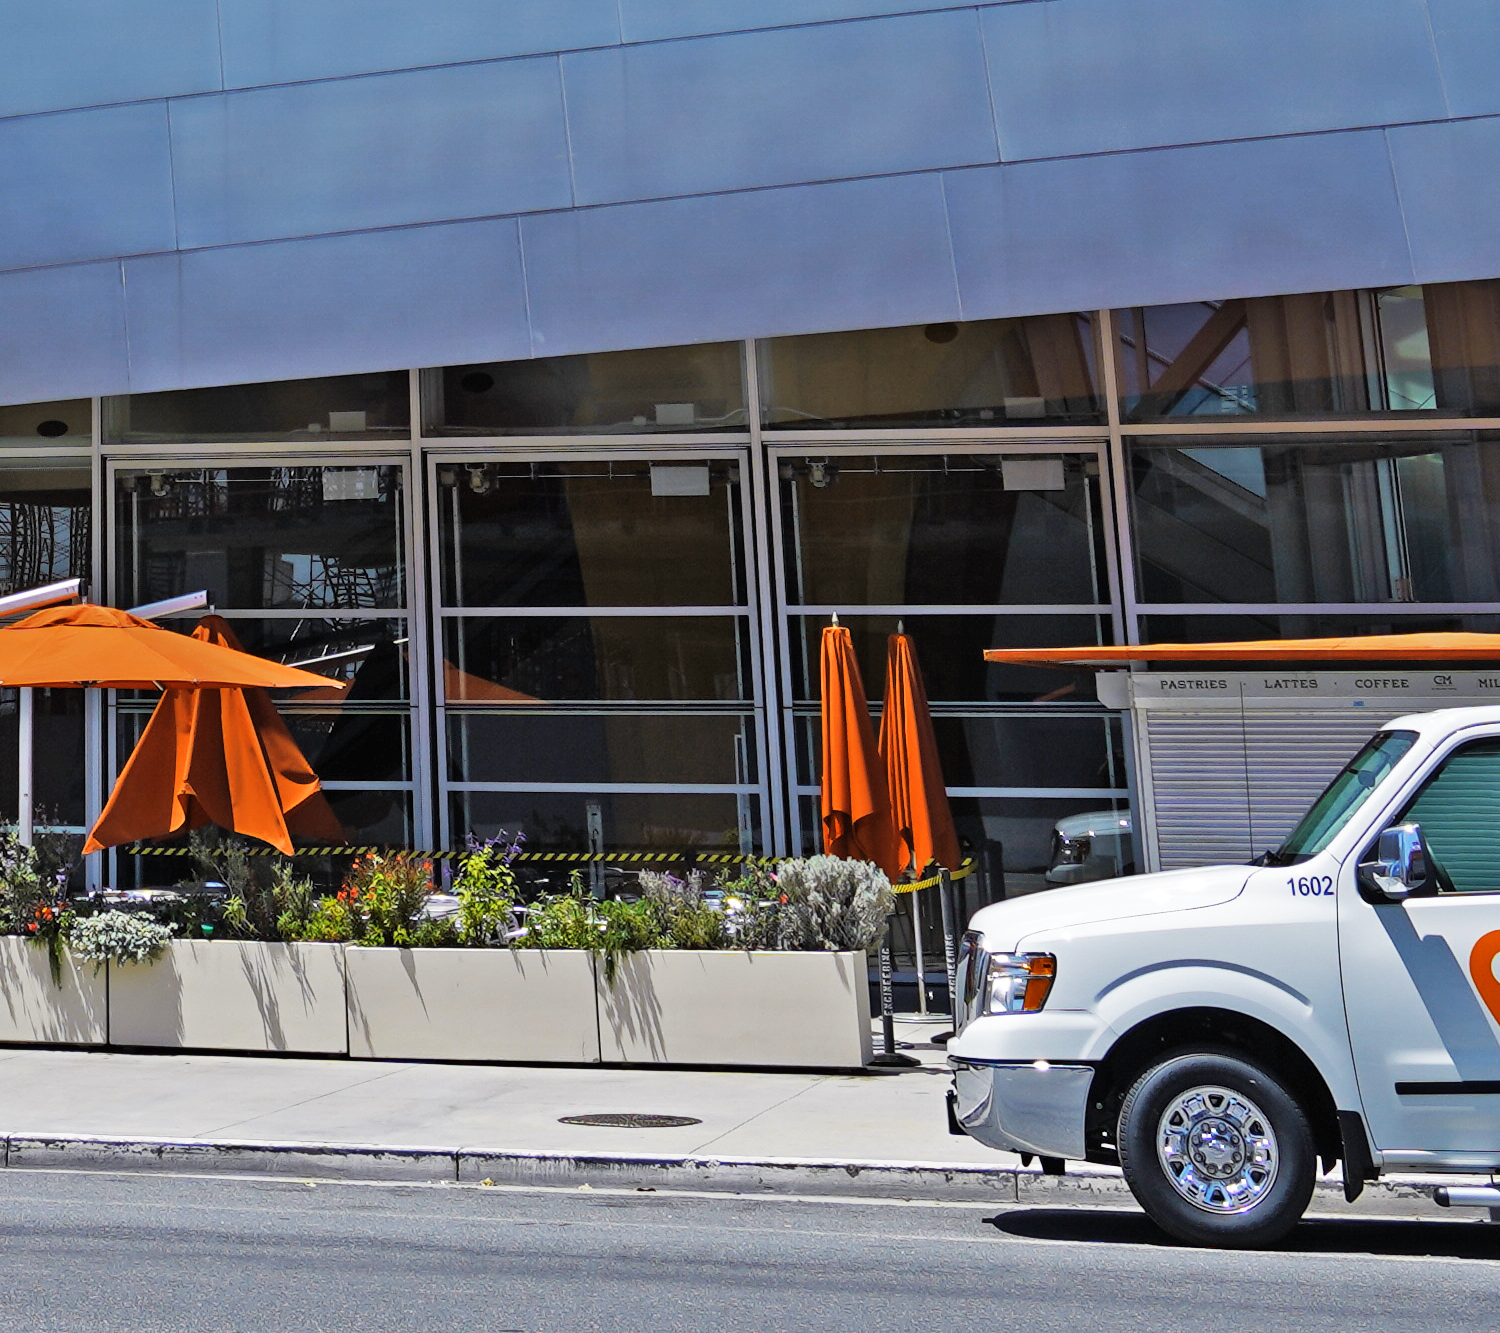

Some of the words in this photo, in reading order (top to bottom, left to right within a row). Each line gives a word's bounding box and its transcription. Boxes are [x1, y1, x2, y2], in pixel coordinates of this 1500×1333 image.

[1161, 679, 1228, 690] PASTRIES
[1264, 679, 1318, 689] LATTES
[1355, 678, 1409, 689] COFFEE
[1287, 876, 1334, 896] 1602
[881, 948, 893, 1016] ENGINEERING
